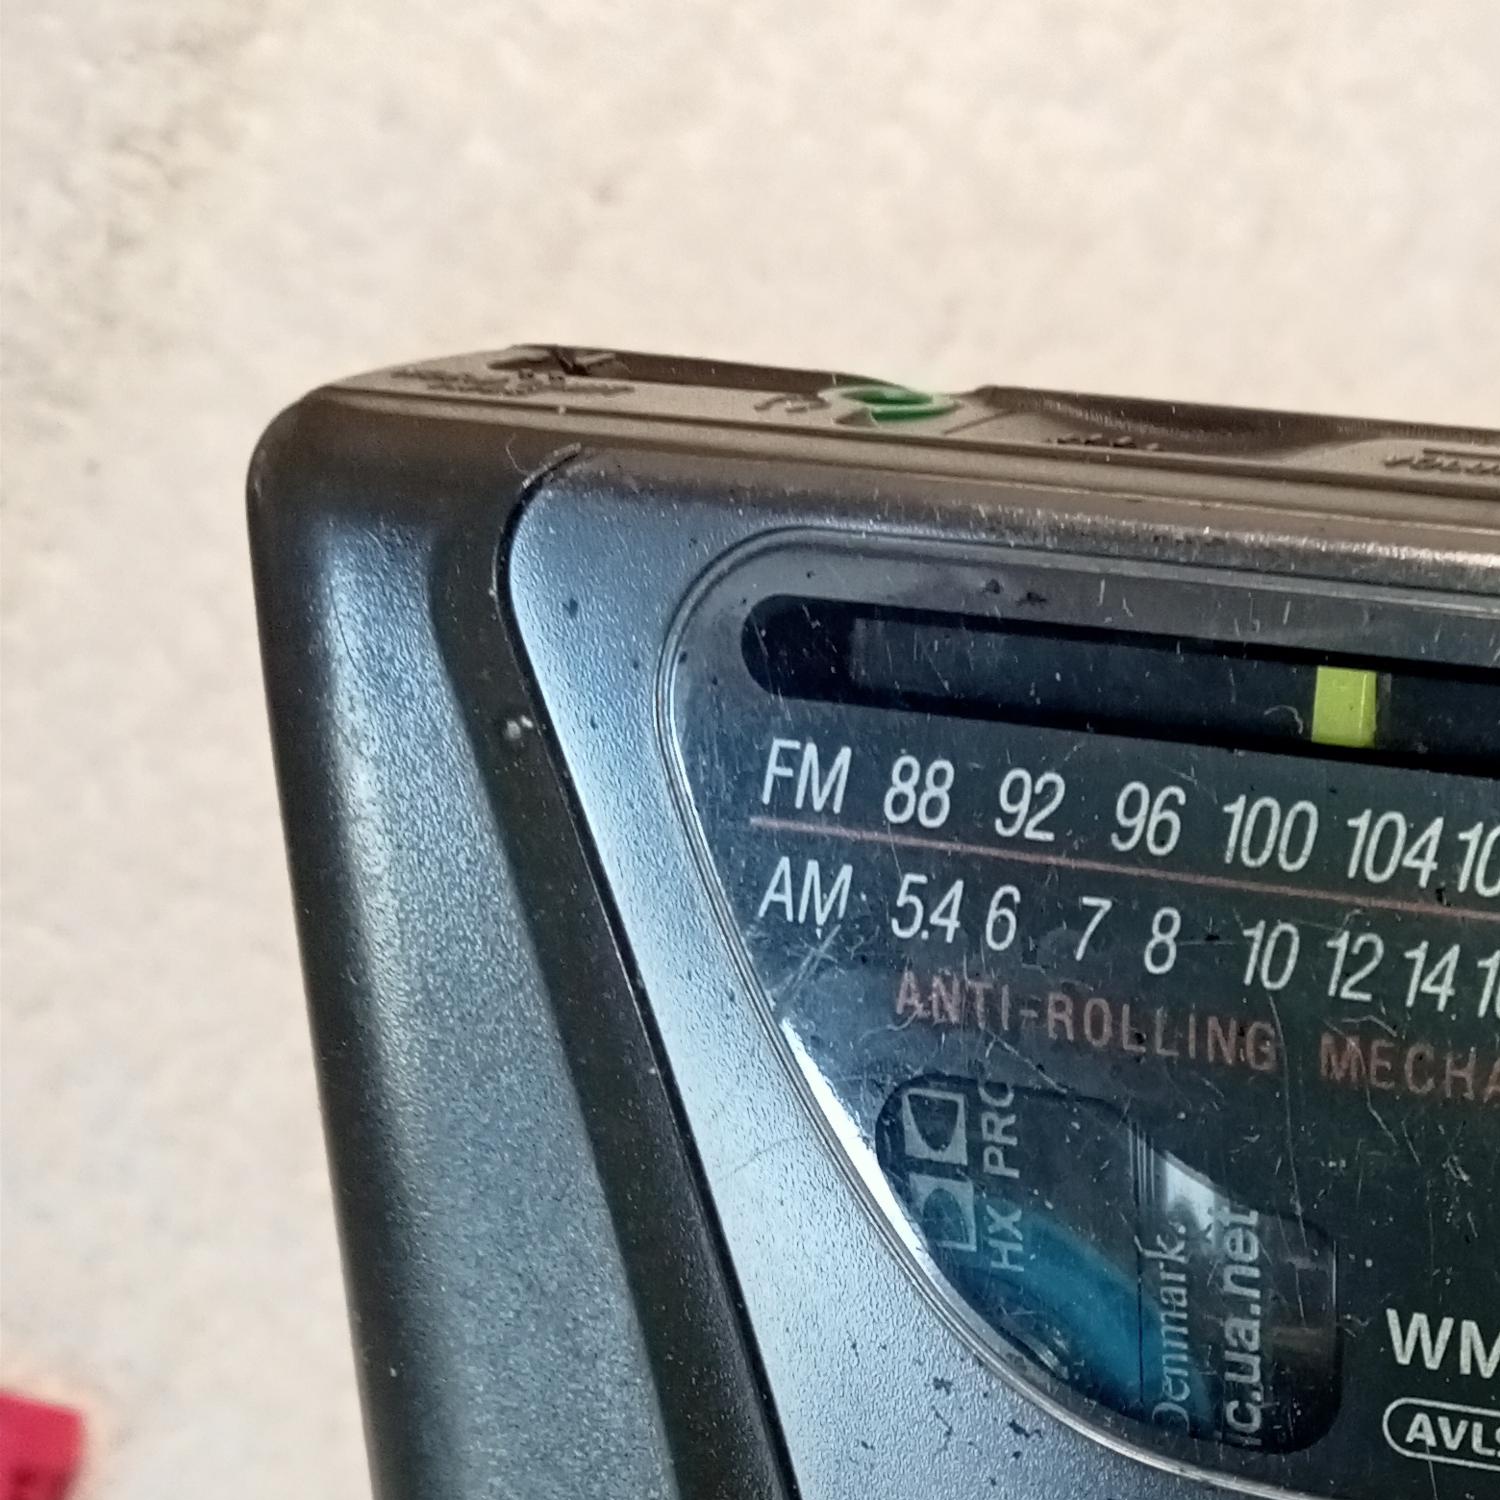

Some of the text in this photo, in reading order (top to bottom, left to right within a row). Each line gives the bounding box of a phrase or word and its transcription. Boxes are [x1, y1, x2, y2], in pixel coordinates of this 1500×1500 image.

[762, 738, 852, 815] FM
[884, 755, 955, 828] 88
[994, 768, 1066, 842] 92
[1111, 781, 1186, 856] 96
[1222, 795, 1318, 873] 100
[1347, 809, 1445, 889] 104
[758, 856, 853, 926] AM
[985, 885, 1020, 951] 6
[1075, 897, 1112, 961] 7
[1144, 907, 1181, 975] 8
[1242, 920, 1300, 991] 10
[1326, 930, 1384, 1002] 12
[1403, 940, 1461, 1012] 14
[896, 966, 1278, 1073] ANTI-ROLLING
[987, 1204, 1025, 1272] HX
